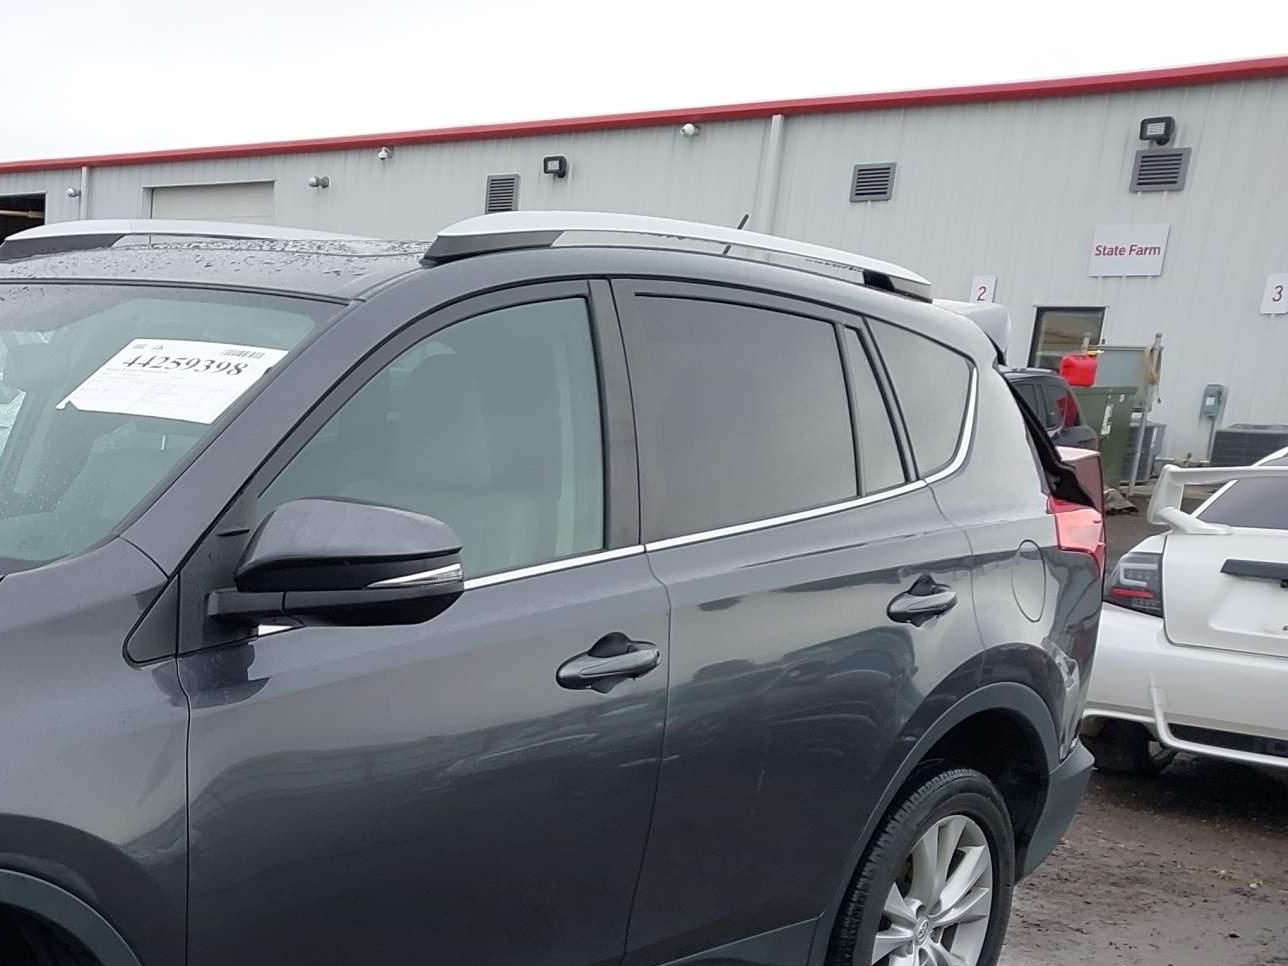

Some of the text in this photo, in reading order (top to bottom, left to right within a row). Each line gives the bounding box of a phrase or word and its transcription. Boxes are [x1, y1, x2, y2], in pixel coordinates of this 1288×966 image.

[1094, 244, 1162, 256] State Farm
[976, 286, 987, 302] 2
[1272, 285, 1284, 302] 3
[122, 354, 249, 377] 44259398
